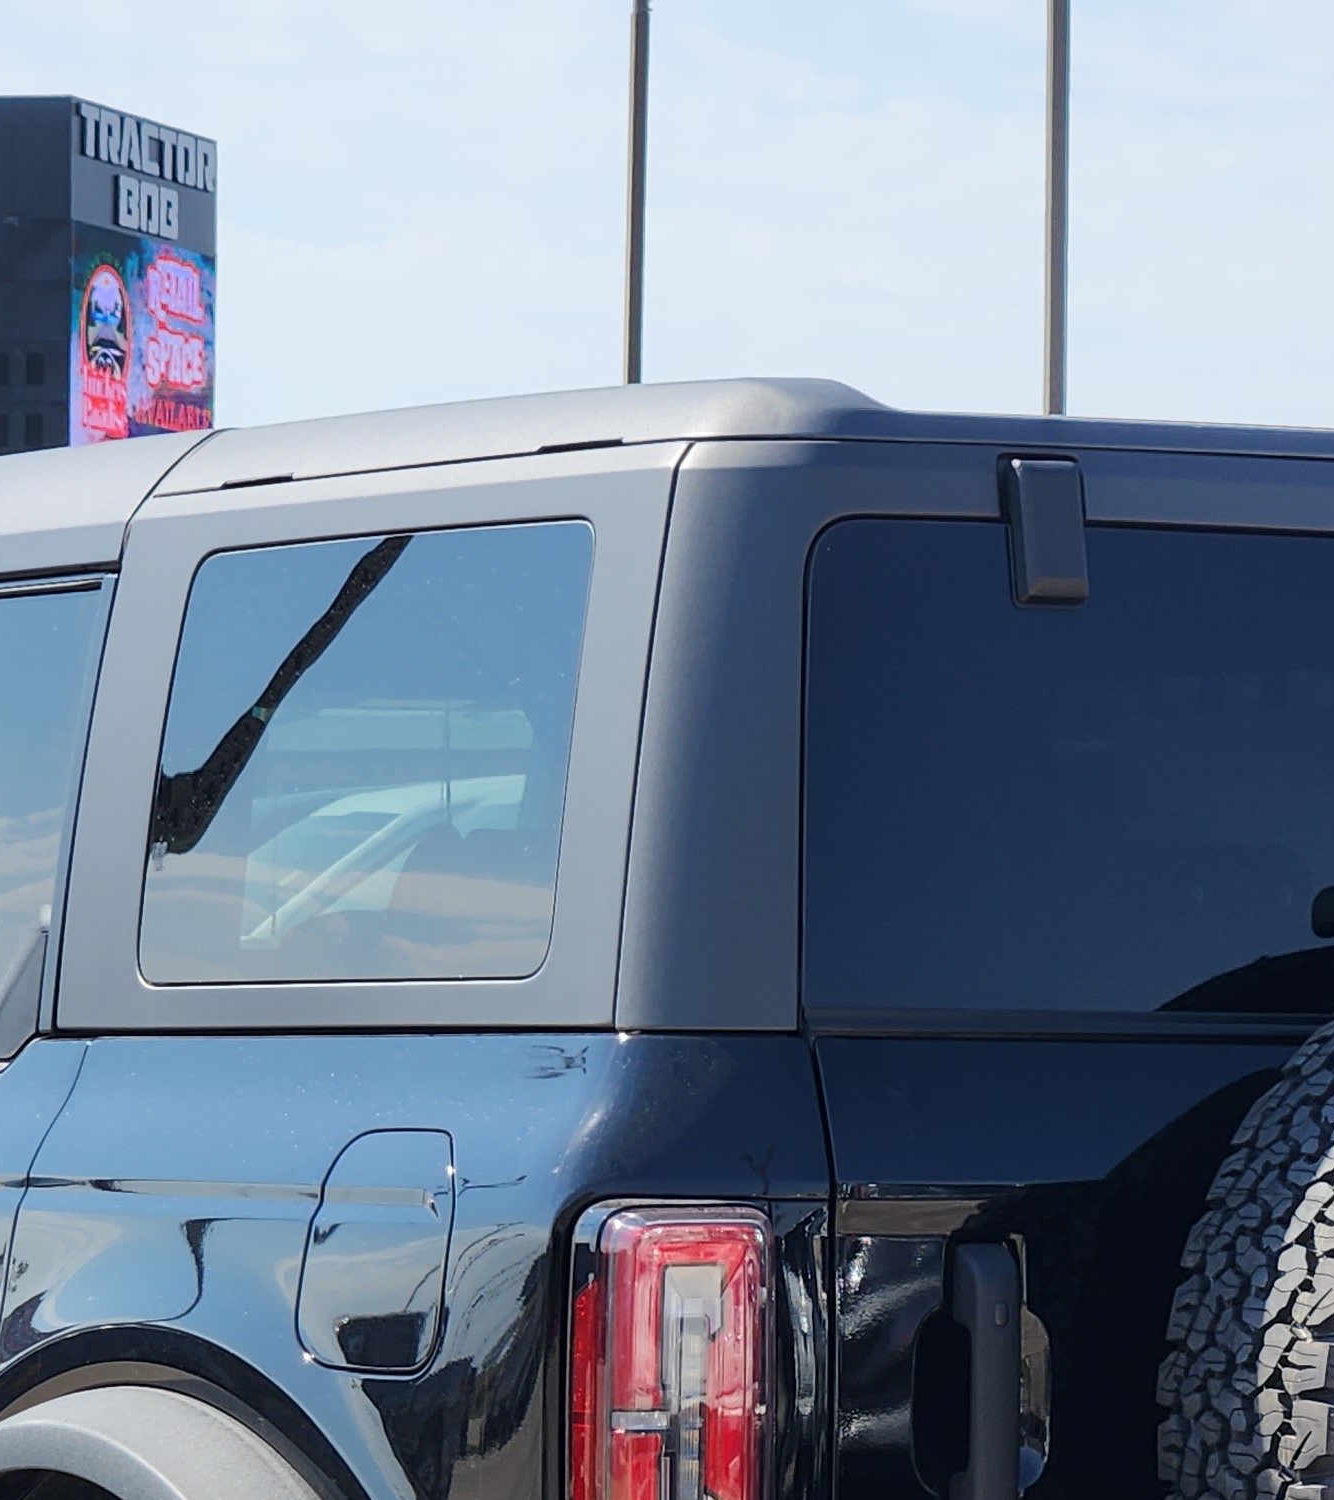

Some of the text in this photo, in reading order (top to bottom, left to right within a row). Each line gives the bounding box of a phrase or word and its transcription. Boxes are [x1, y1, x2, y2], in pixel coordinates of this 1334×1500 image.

[80, 103, 216, 192] TRACTOR
[117, 174, 179, 240] BOB
[147, 258, 204, 324] RETAIL
[146, 330, 204, 388] SPACE
